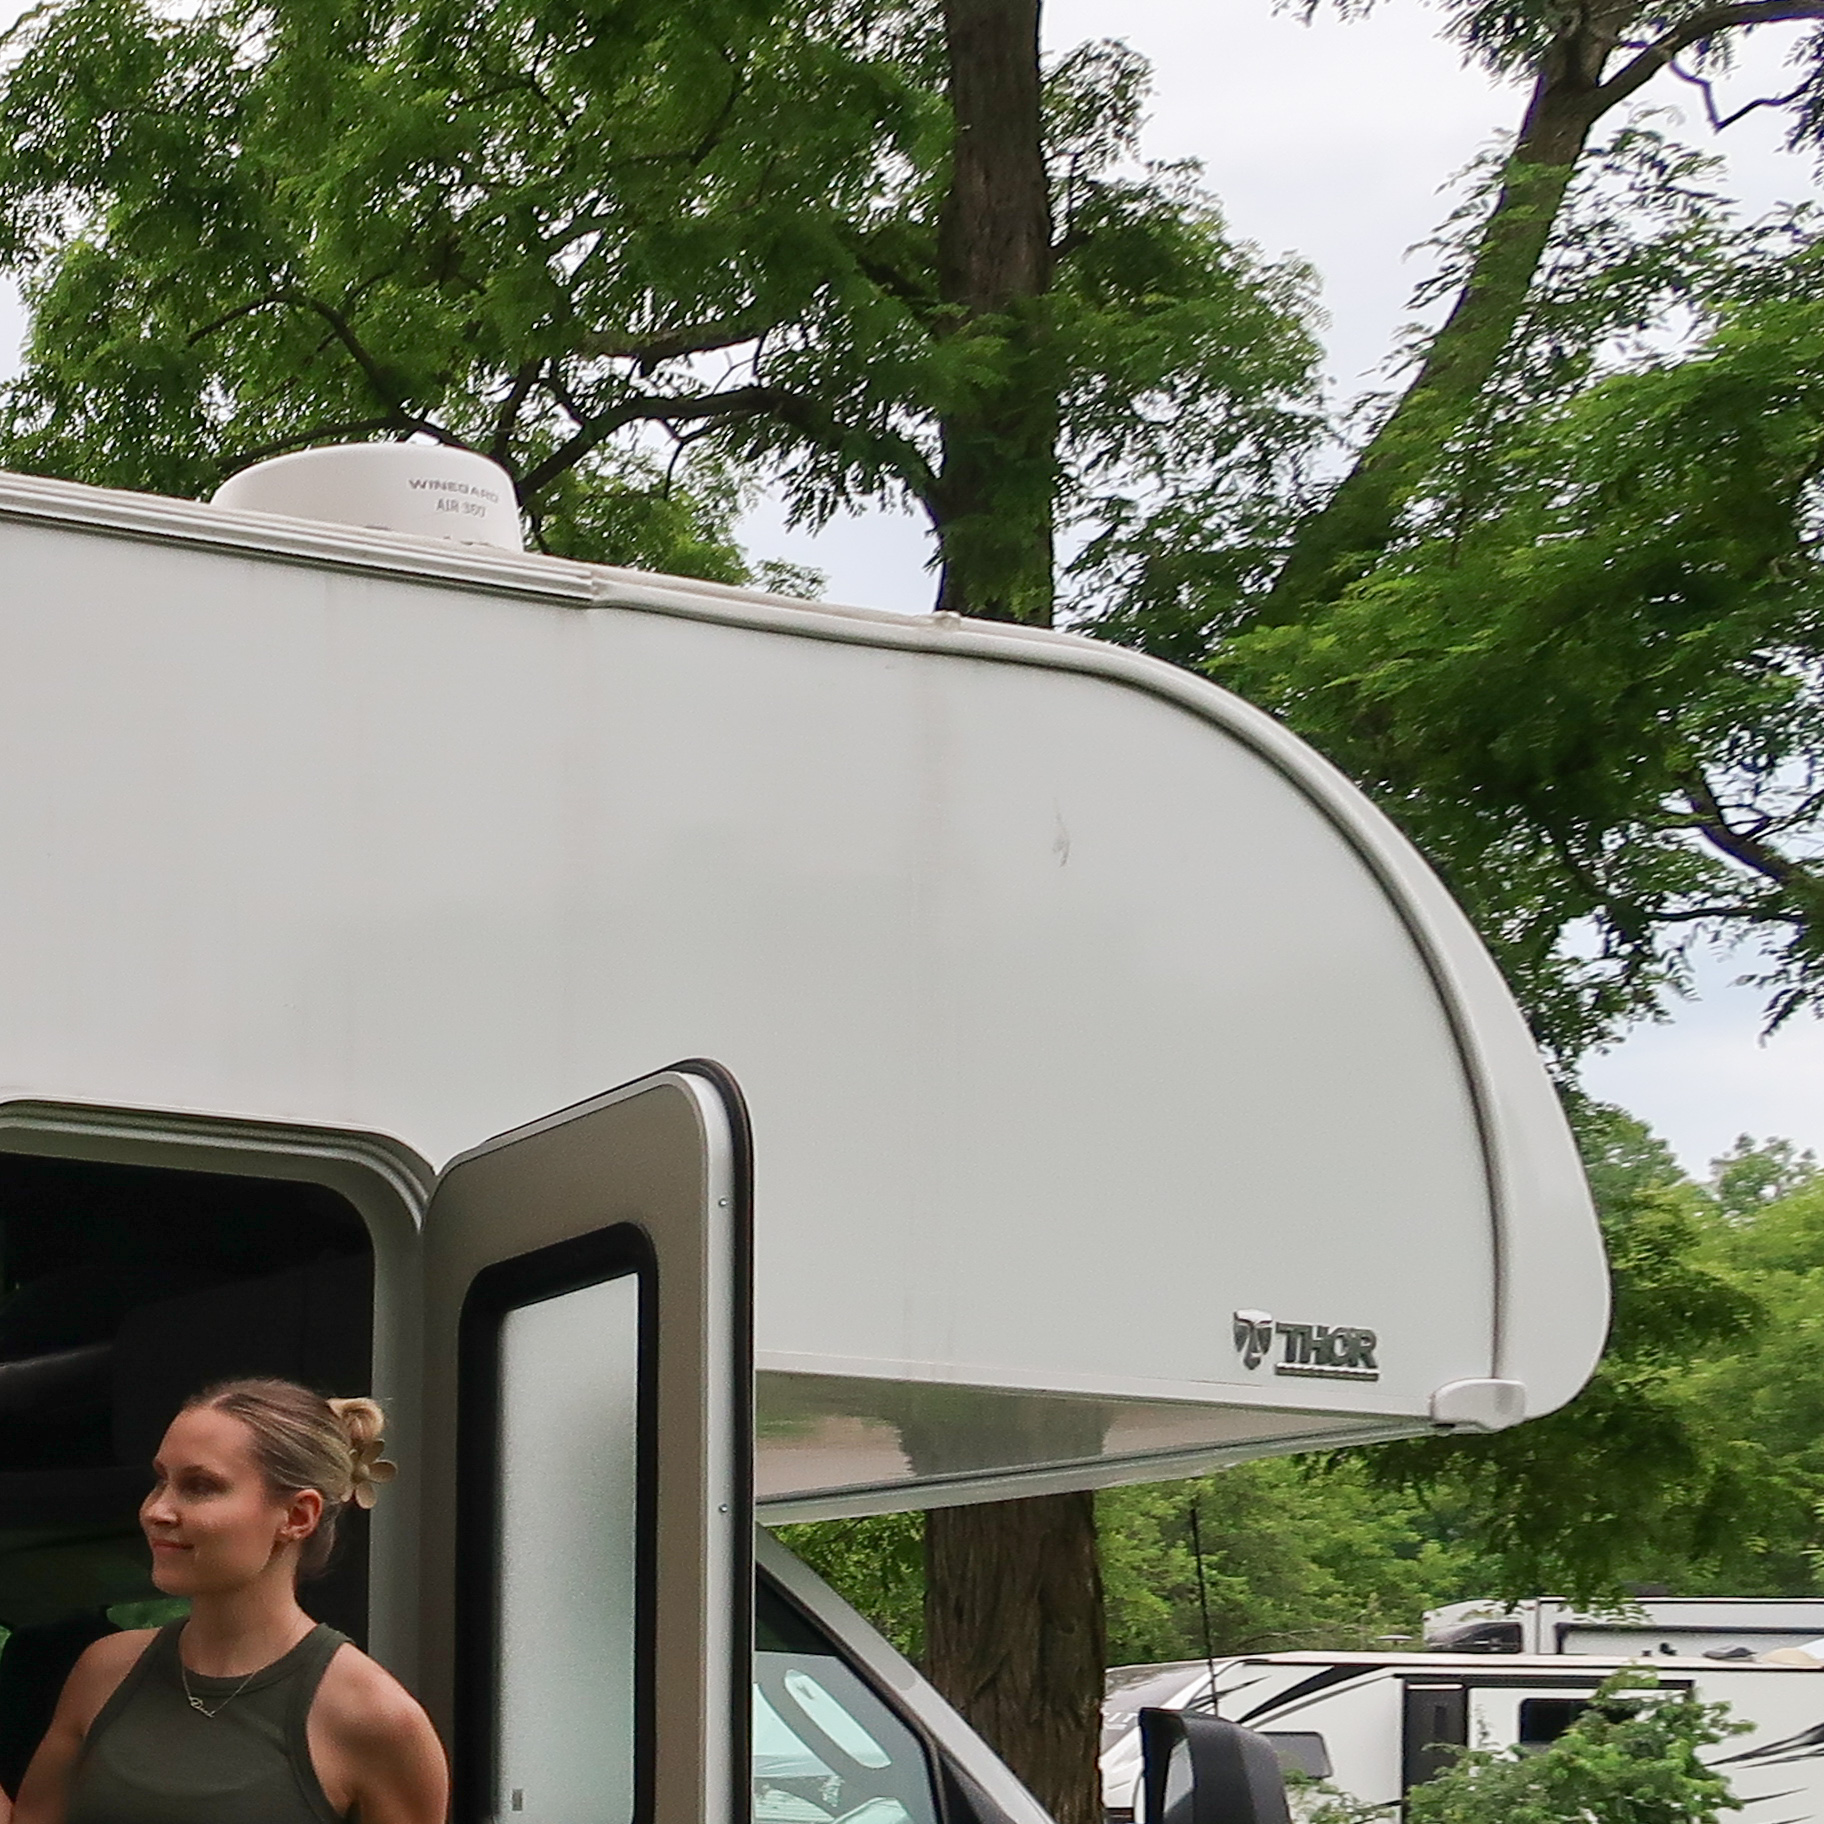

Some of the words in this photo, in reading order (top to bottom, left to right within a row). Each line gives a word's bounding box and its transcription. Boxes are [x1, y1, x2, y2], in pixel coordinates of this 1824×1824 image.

[408, 479, 499, 503] WINEGARD
[435, 497, 459, 514] AIR
[1275, 1321, 1378, 1369] THOR
